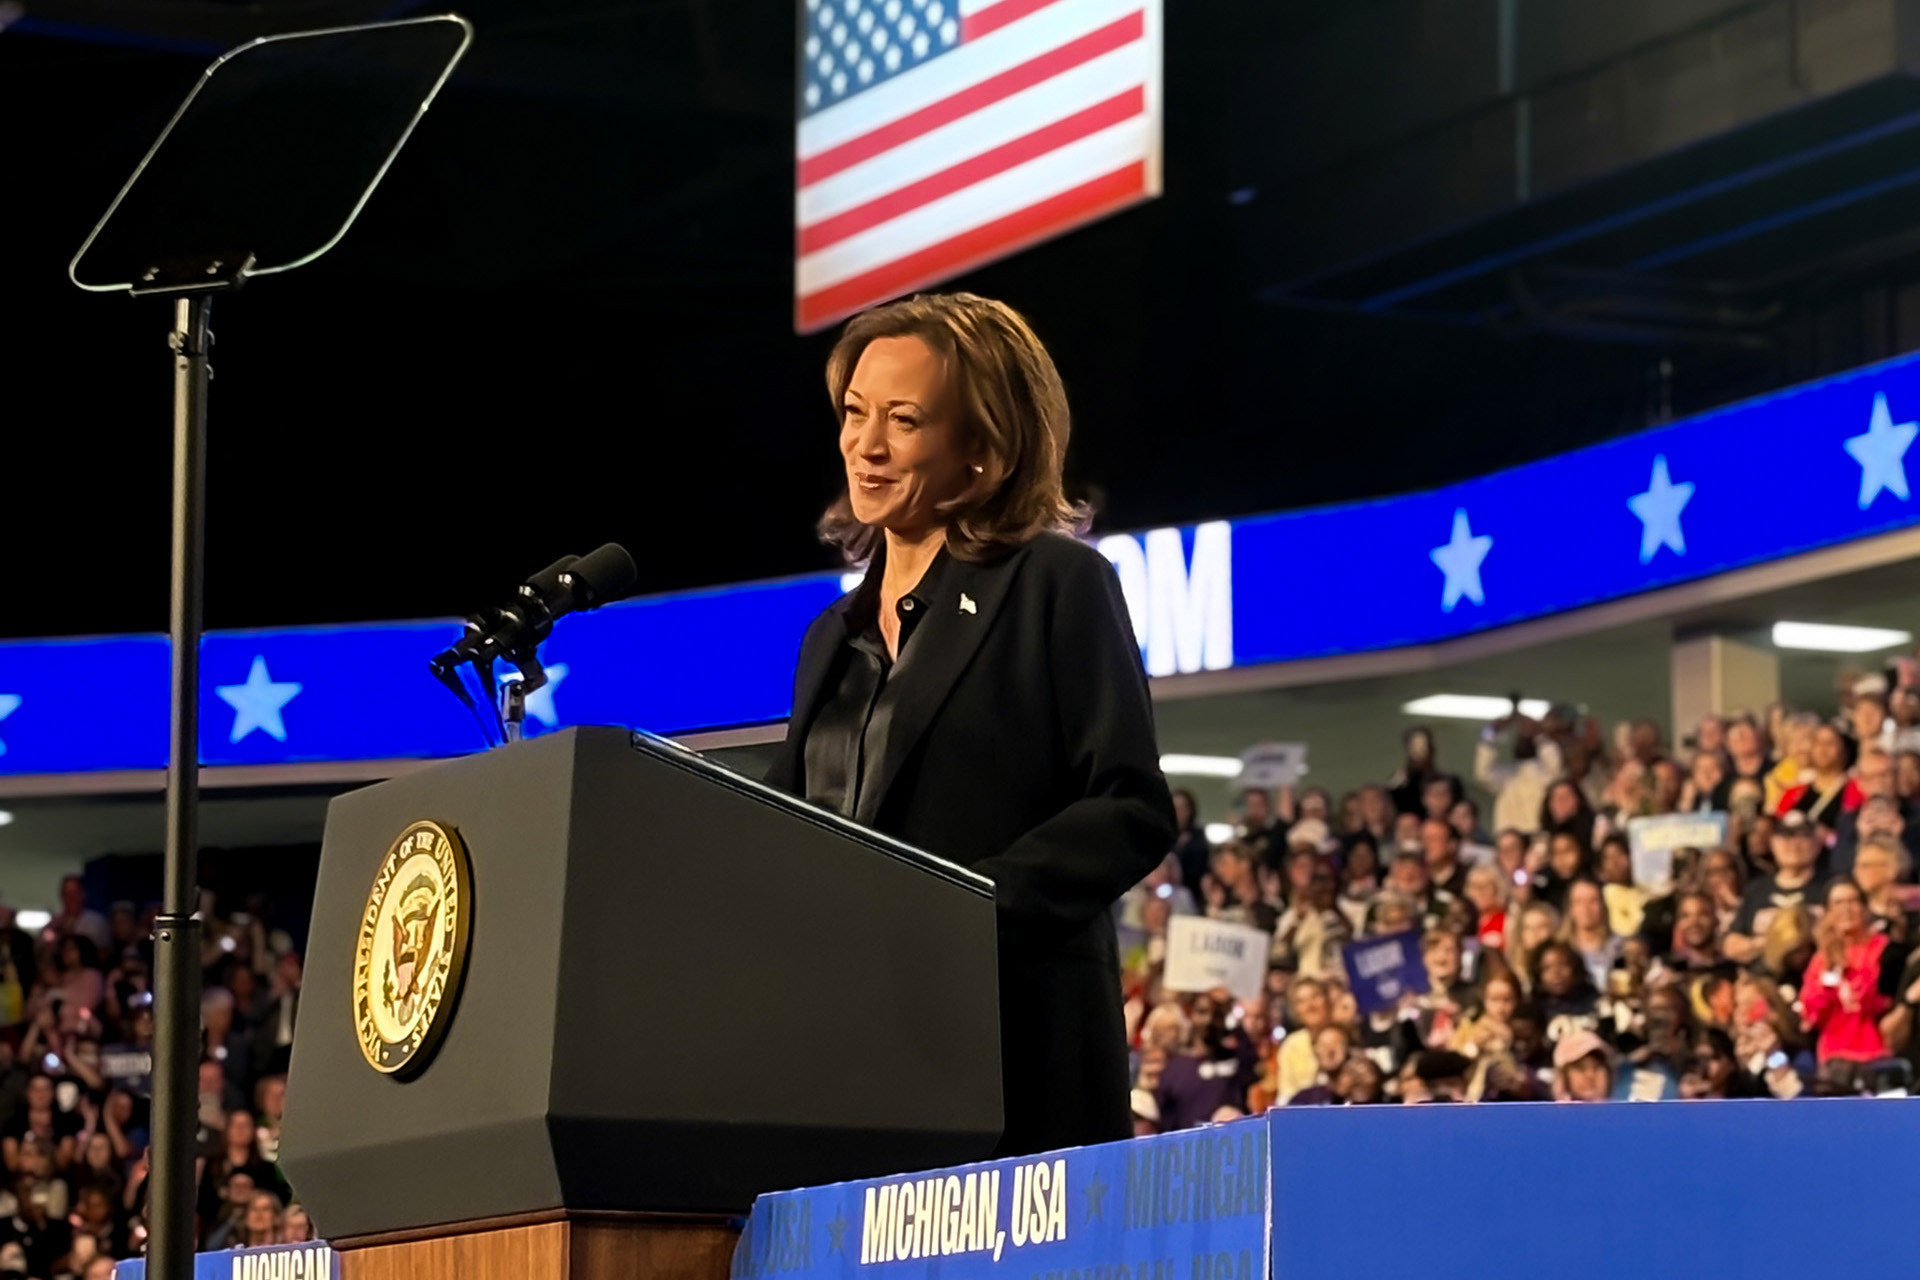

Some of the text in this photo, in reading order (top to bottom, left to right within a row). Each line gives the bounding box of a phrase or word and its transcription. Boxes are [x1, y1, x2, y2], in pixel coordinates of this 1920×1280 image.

[400, 836, 415, 859] OF
[860, 1169, 1006, 1264] MICHIGAN,
[1011, 1159, 1067, 1247] USA
